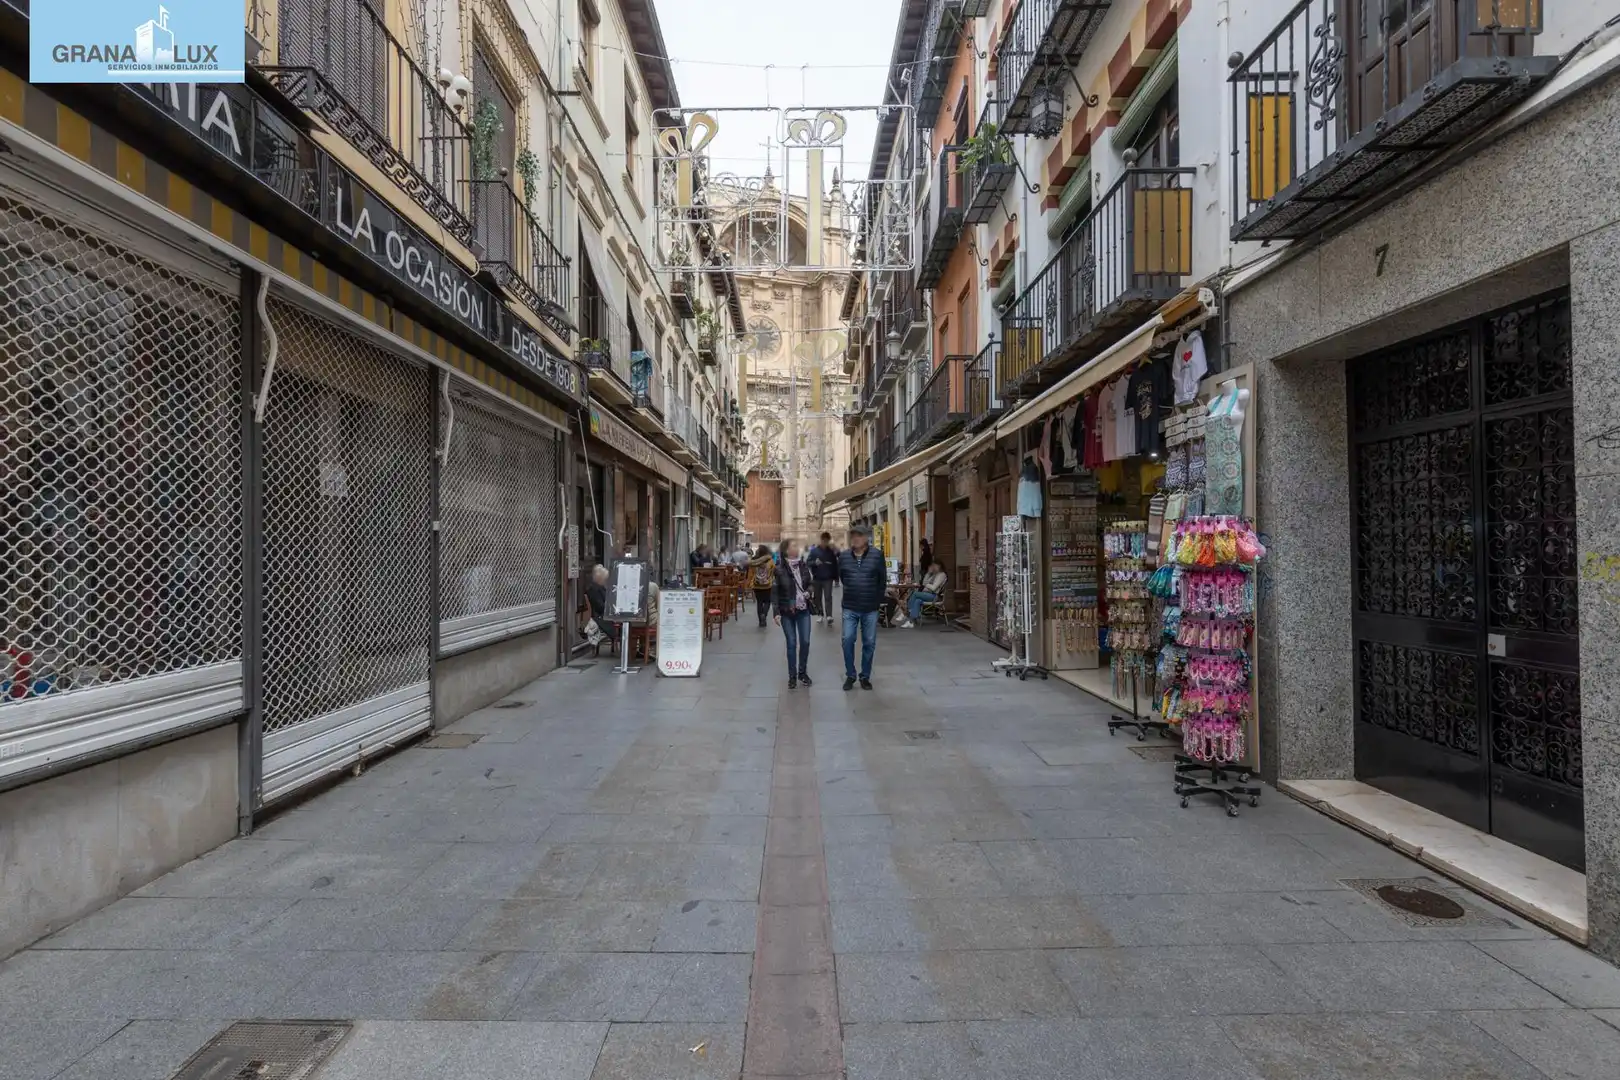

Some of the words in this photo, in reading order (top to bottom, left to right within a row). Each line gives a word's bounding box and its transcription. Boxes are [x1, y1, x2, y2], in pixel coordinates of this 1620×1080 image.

[337, 187, 376, 253] LA
[385, 230, 484, 330] OCASIÓN
[1375, 242, 1390, 278] 7
[511, 327, 552, 378] DESDE
[554, 362, 577, 393] 1908
